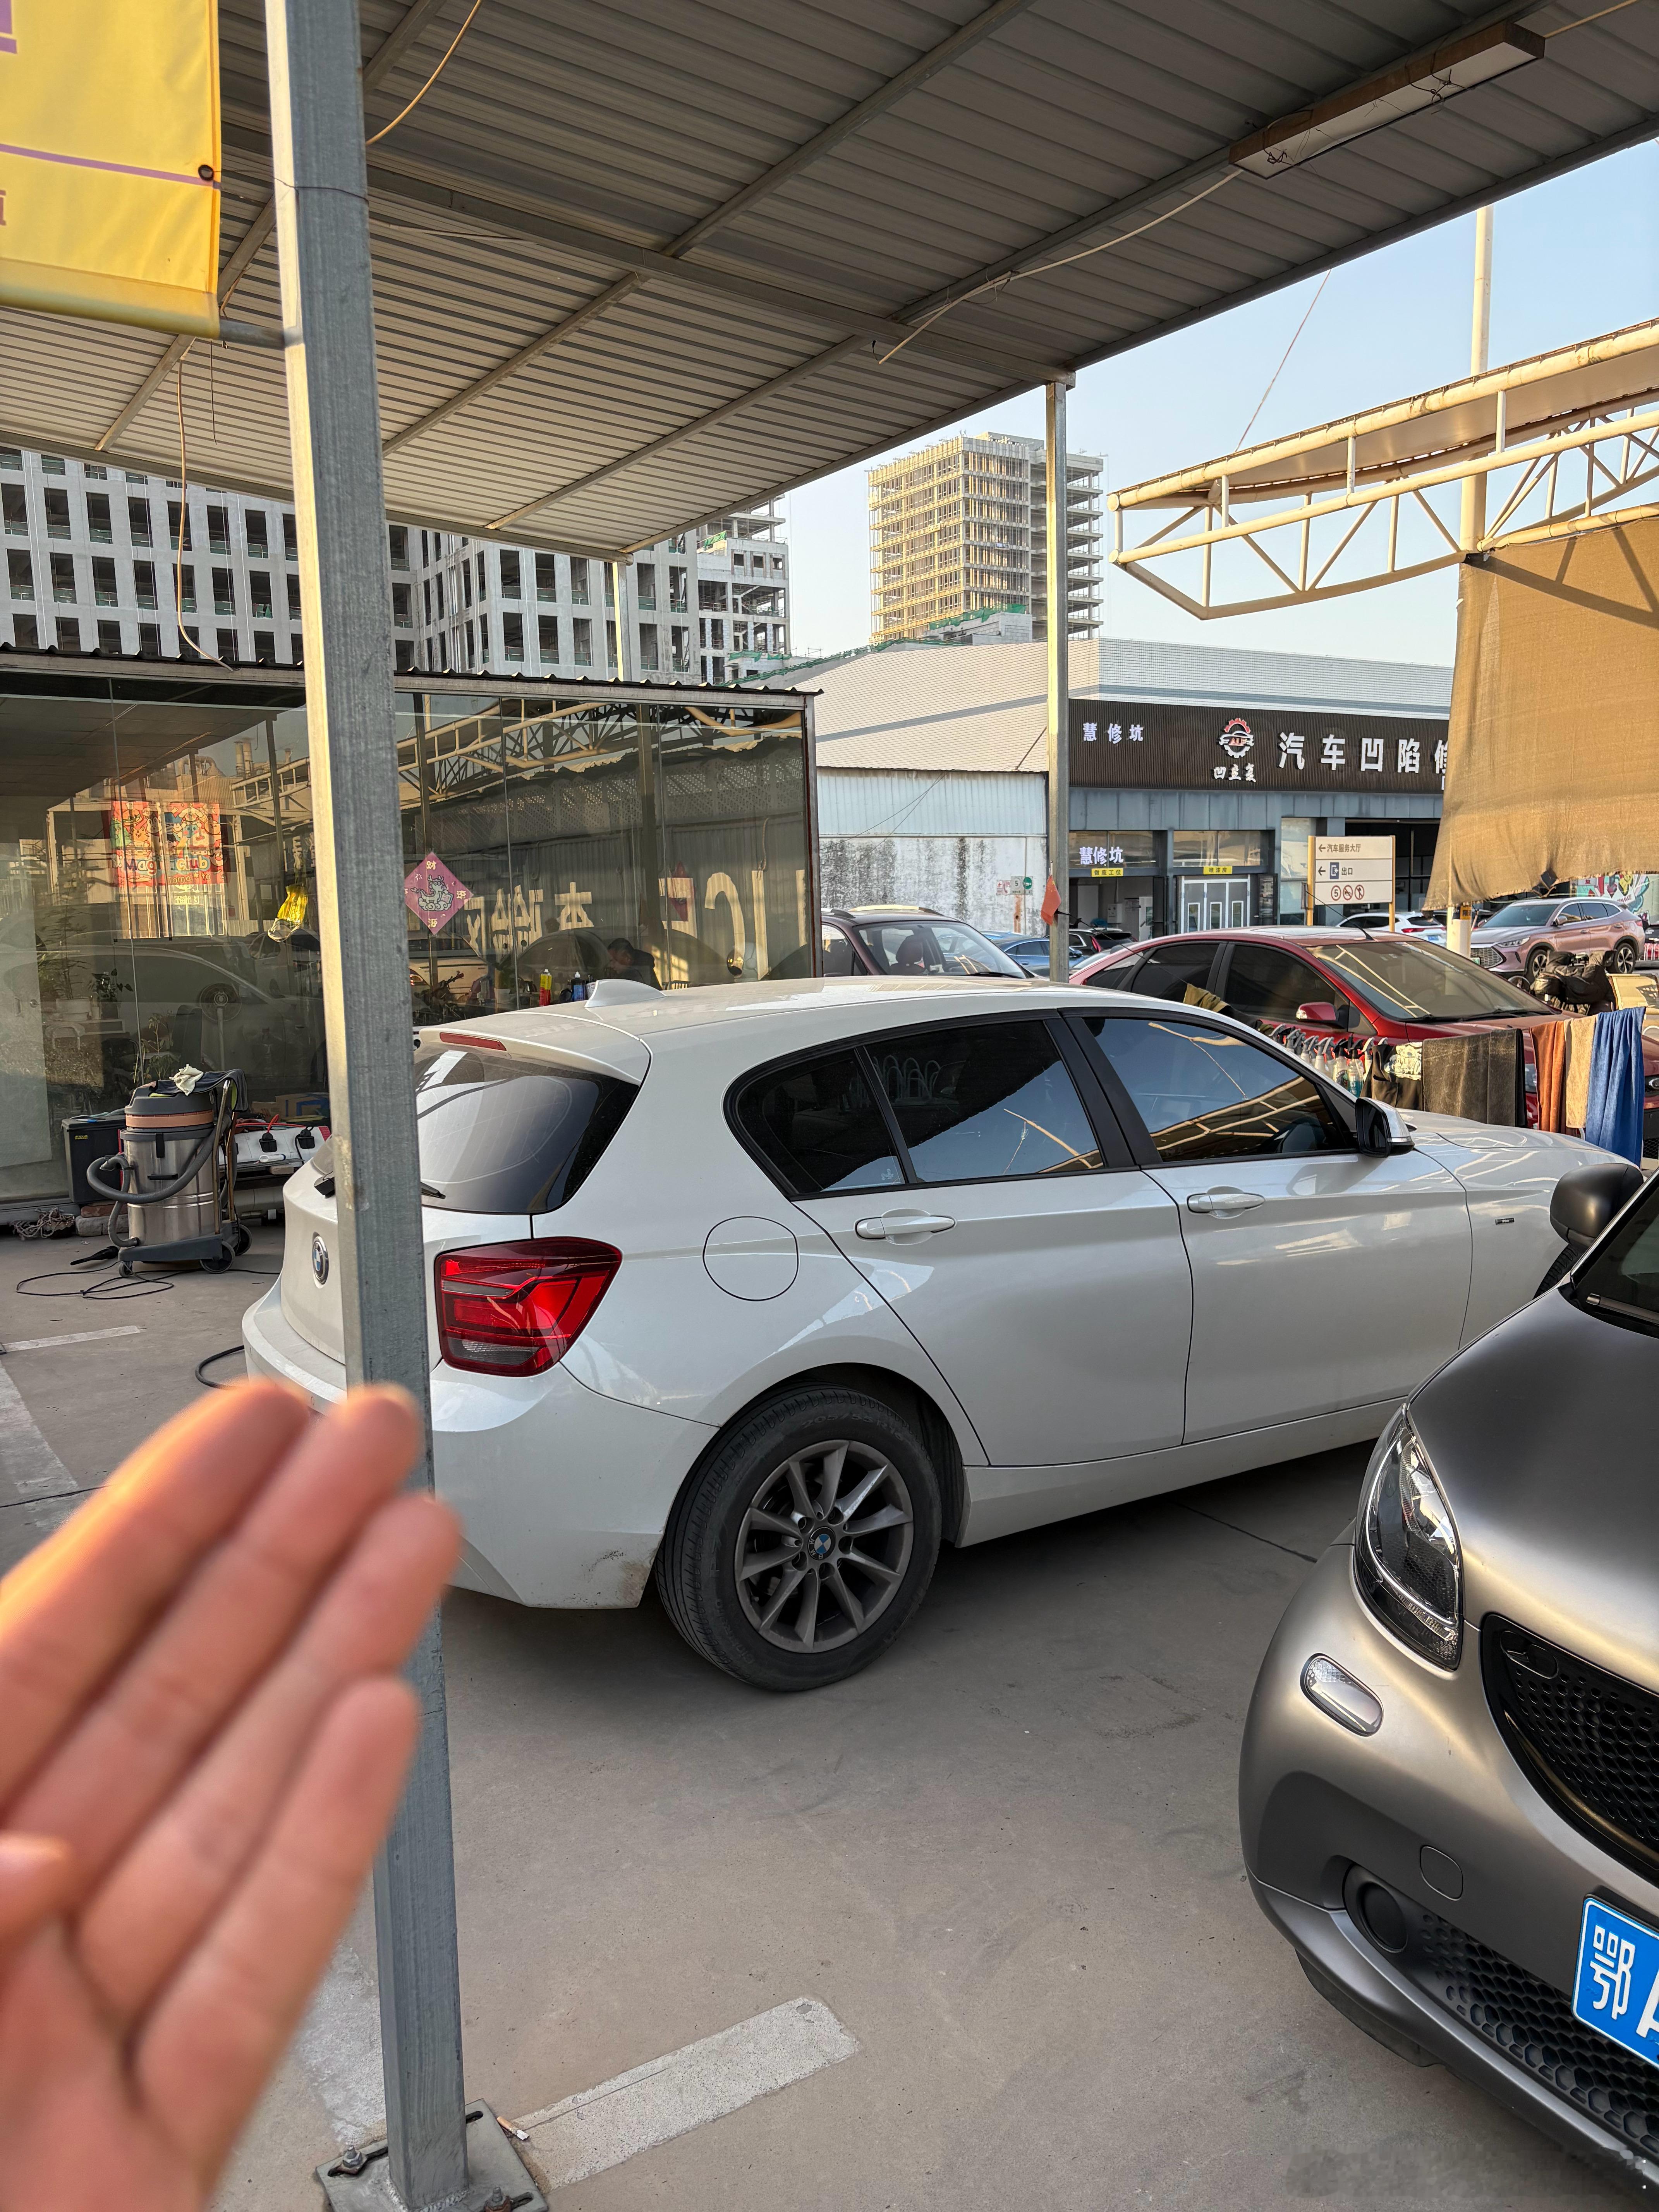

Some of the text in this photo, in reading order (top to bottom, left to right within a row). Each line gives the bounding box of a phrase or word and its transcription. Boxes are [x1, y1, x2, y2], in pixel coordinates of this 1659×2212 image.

[1083, 722, 1144, 744] 慧修坑
[1327, 844, 1361, 852] 汽车服务大厅
[176, 854, 208, 871] club
[1079, 847, 1123, 865] 慧修坑
[426, 860, 437, 870] 财
[1341, 867, 1353, 875] 出口
[1334, 889, 1338, 898] 5
[809, 1538, 823, 1559] BMW
